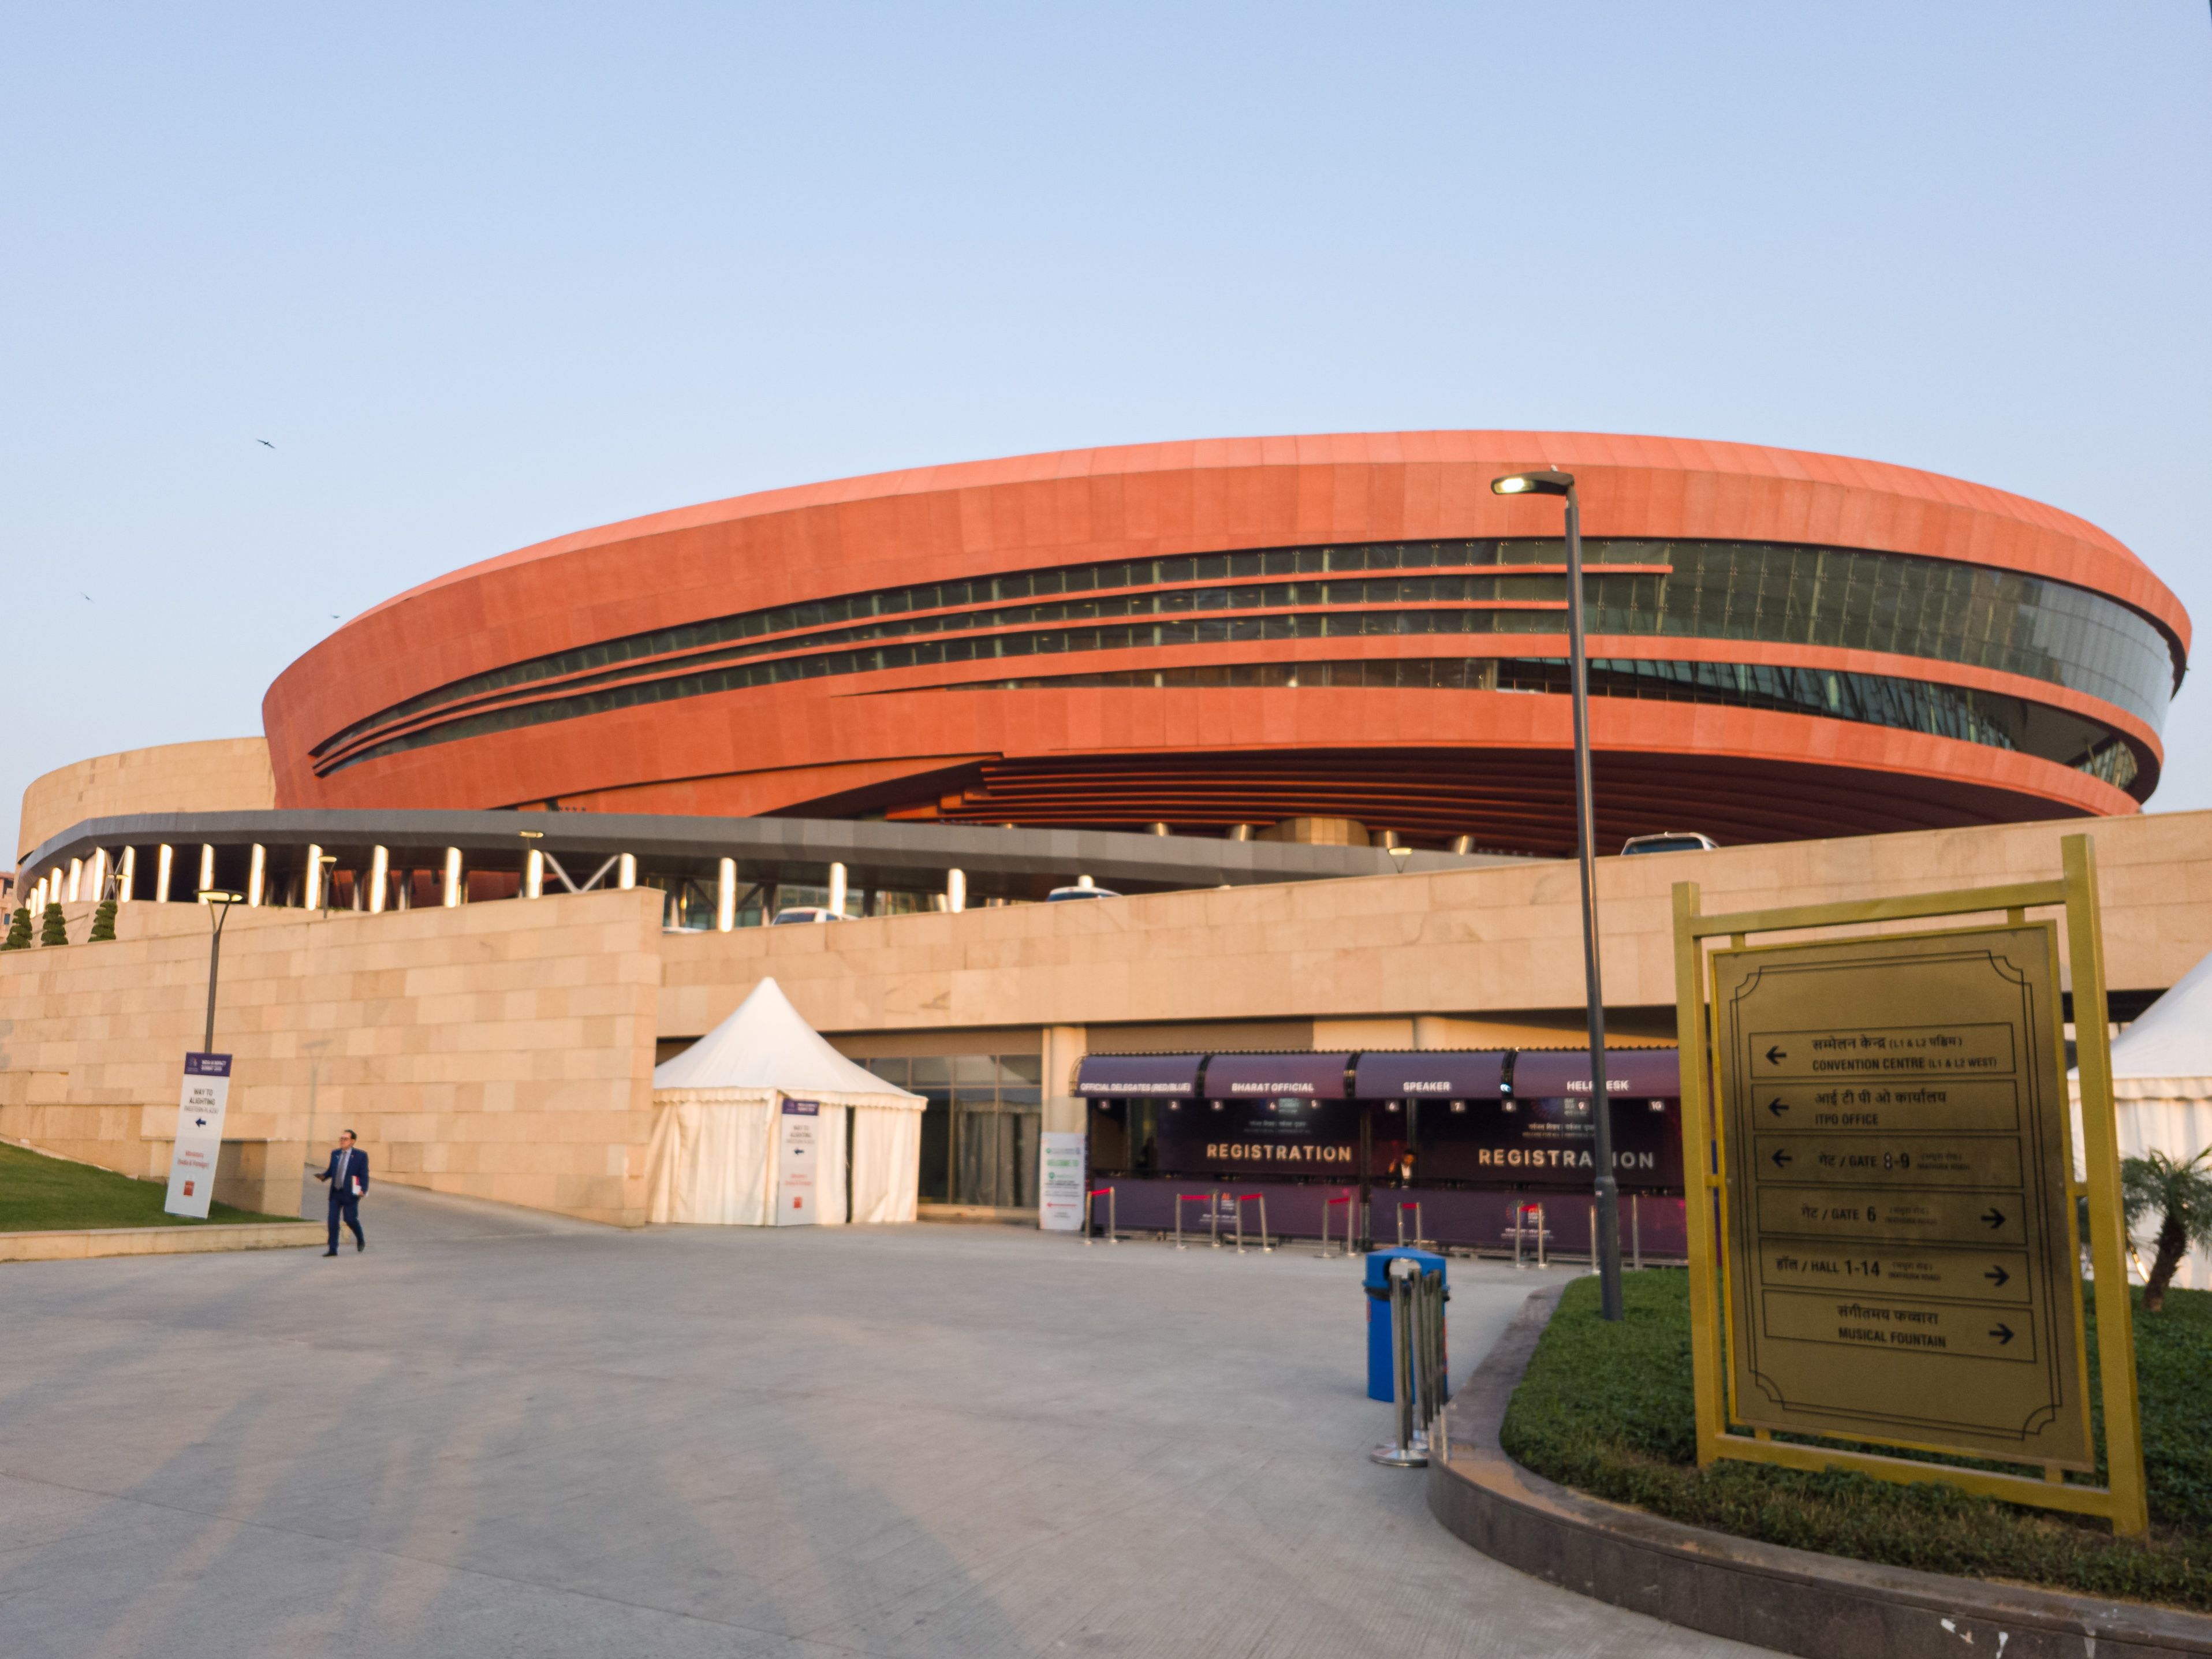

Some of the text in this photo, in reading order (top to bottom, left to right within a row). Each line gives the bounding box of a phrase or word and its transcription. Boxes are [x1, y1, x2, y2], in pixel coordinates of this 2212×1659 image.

[1812, 1035, 1856, 1050] सम्मेलन
[1812, 1058, 1879, 1072] CONVENTION
[1883, 1057, 1924, 1069] CENTRE
[1968, 1057, 1997, 1067] WEST)
[1232, 1083, 1314, 1093] BHARAT OFFICIAL
[1403, 1082, 1451, 1092] SPEAKER
[1606, 1080, 1629, 1091] ESK
[189, 1097, 215, 1105] ALIGHTING
[1815, 1088, 1837, 1106] आई
[1842, 1089, 1853, 1104] टी
[1858, 1089, 1870, 1103] पी
[1894, 1088, 1946, 1103] कार्यालय
[1815, 1113, 1878, 1125] ITPO OFFICE
[1207, 1144, 1352, 1161] REGISTRATION
[1479, 1149, 1654, 1169] REGISTRAION
[1849, 1155, 1877, 1168] GATE
[1831, 1209, 1859, 1220] GATE
[1867, 1206, 1876, 1222] 6
[1811, 1261, 1839, 1273] HALL
[1845, 1260, 1879, 1276] 1-14
[1839, 1328, 1945, 1348] MUSICAL FOUNTAIN
